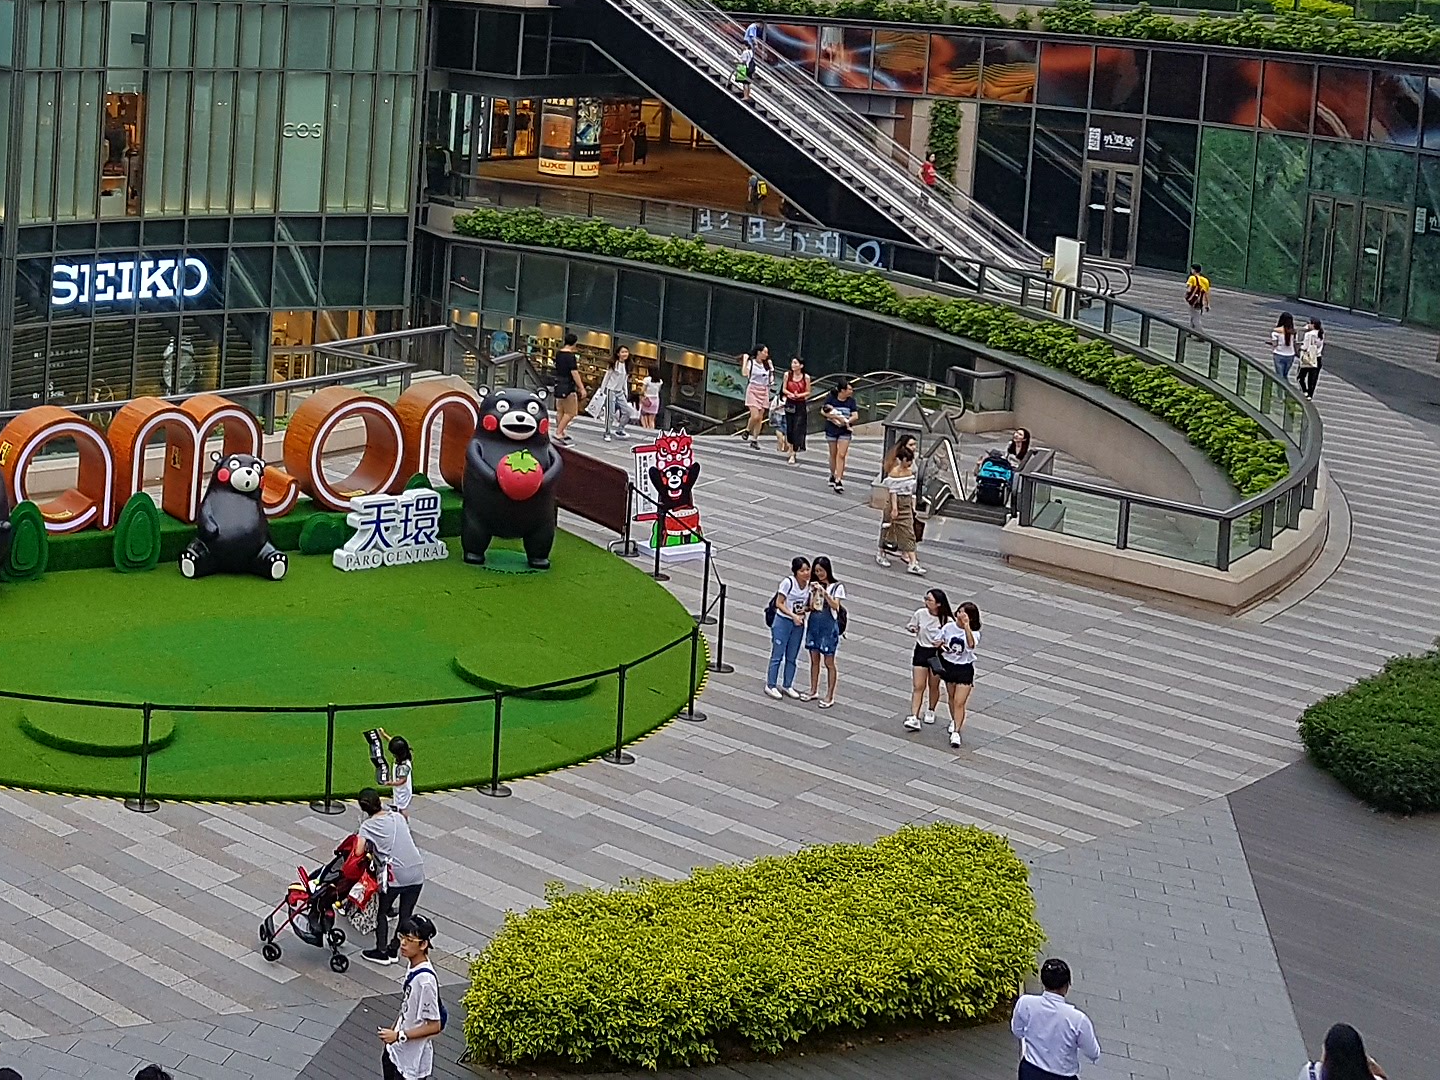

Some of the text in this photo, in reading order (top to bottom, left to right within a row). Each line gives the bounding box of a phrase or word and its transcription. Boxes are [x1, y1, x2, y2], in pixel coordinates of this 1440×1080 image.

[282, 122, 322, 139] COS
[51, 257, 208, 305] SEIKO
[358, 496, 439, 552] 天環
[345, 545, 447, 568] PARC CENTRAL
